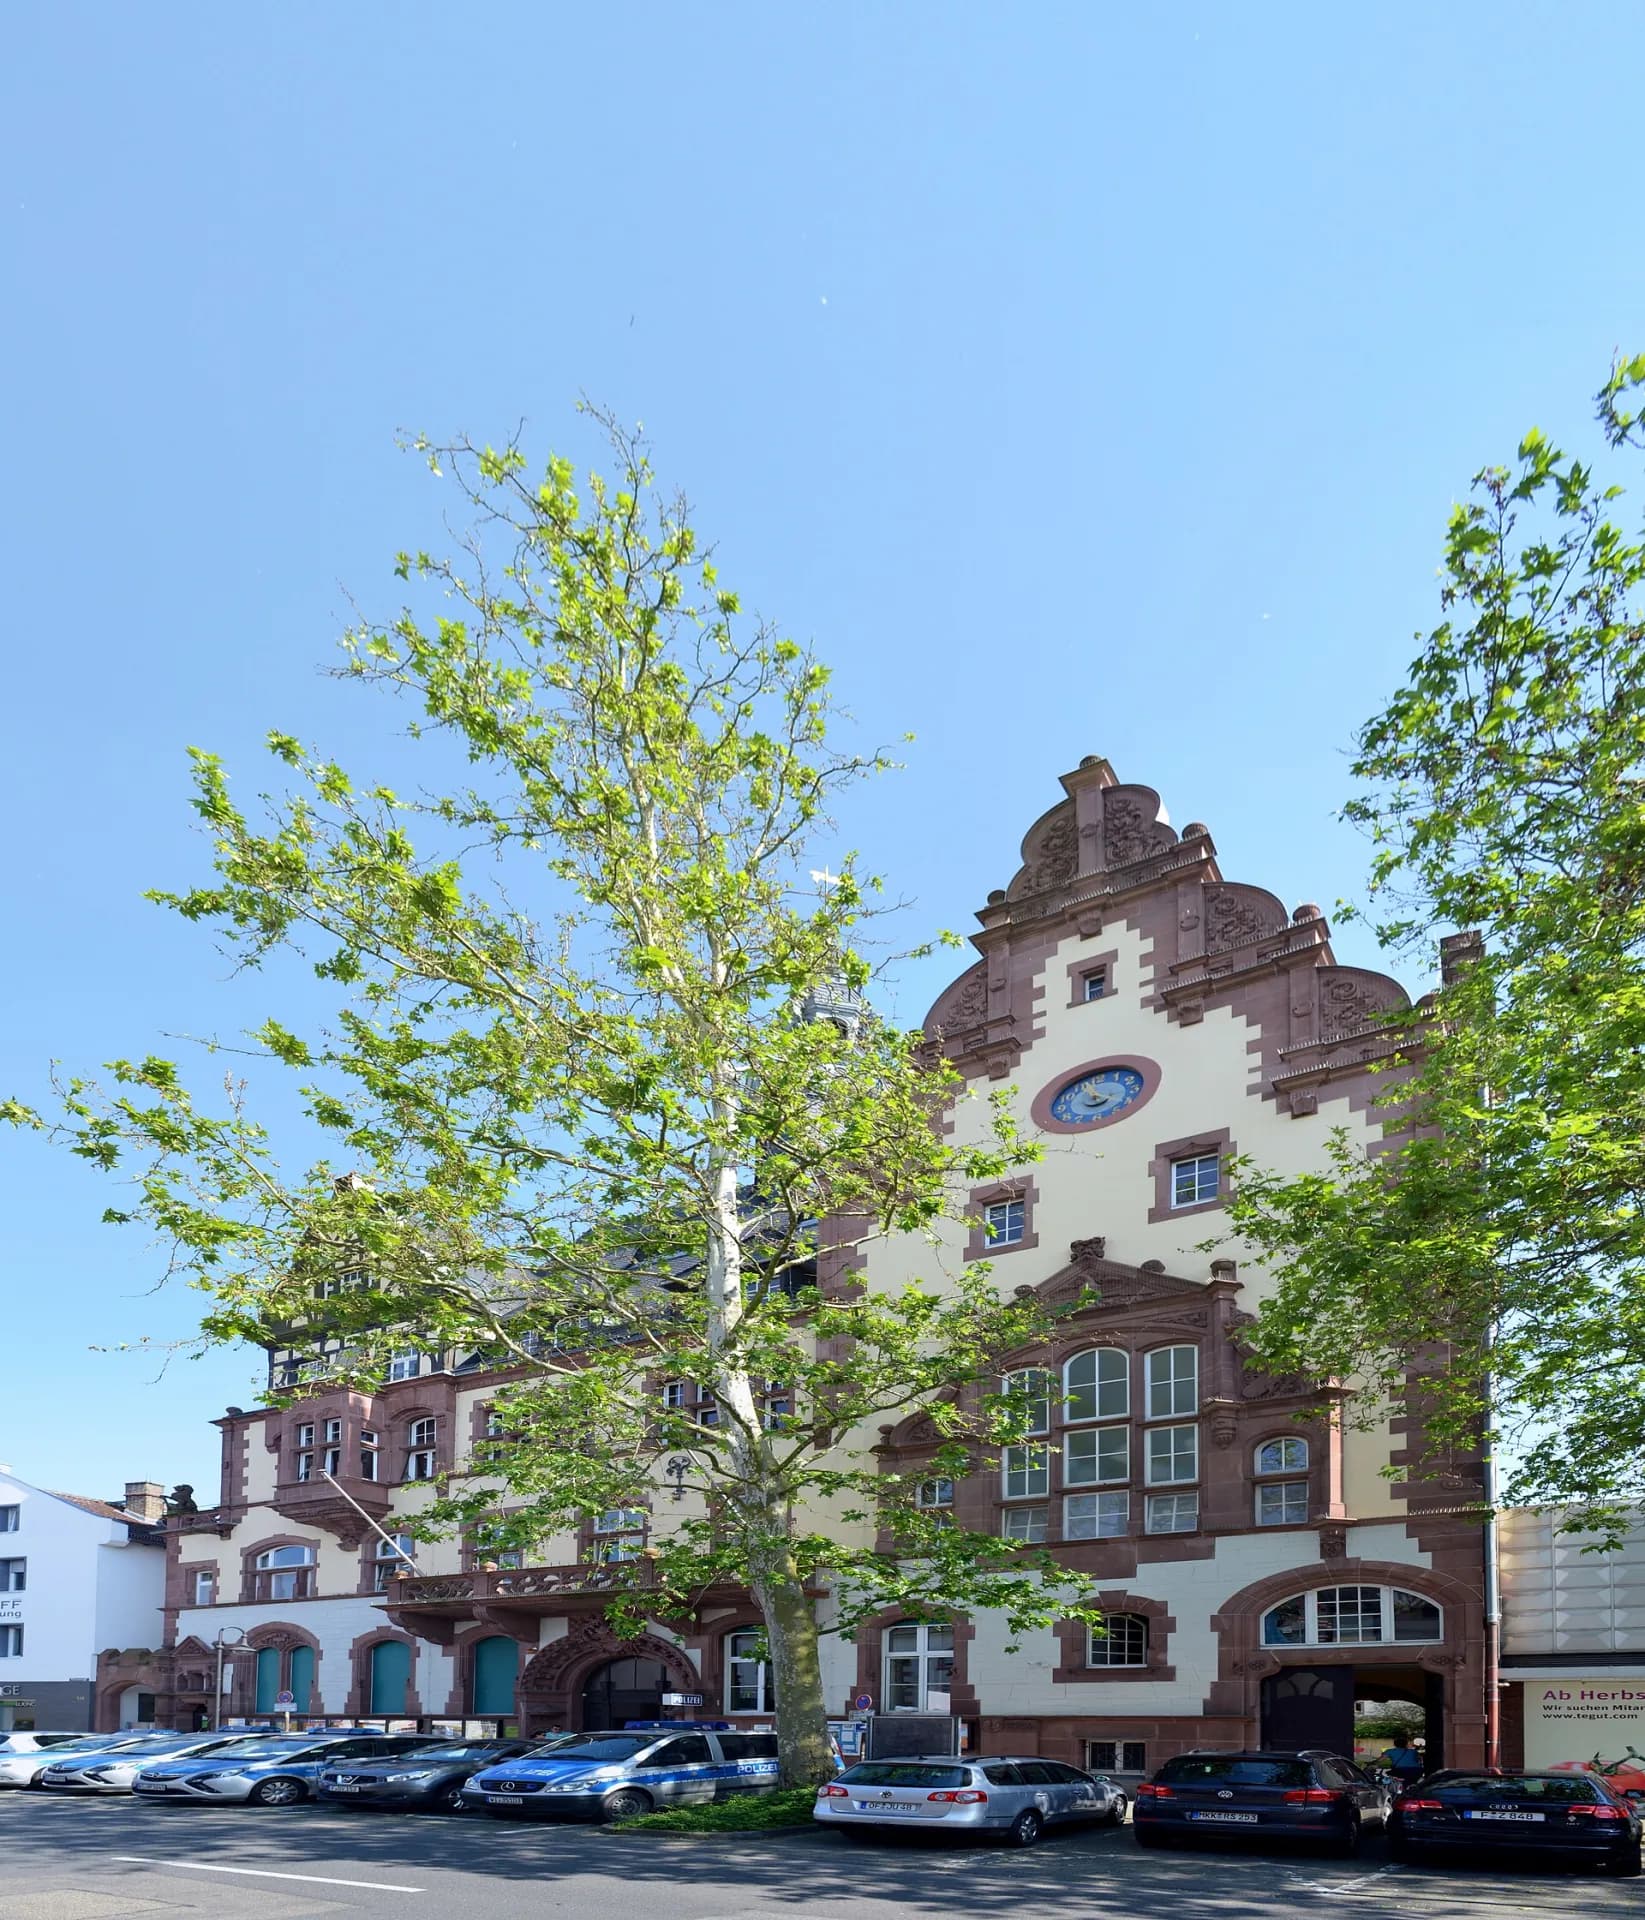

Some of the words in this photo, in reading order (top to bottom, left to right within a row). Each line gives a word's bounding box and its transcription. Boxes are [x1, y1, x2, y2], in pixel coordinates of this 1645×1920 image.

[0, 1600, 22, 1609] FF
[0, 1685, 20, 1696] GE
[1543, 1690, 1571, 1700] Ab
[1581, 1690, 1645, 1700] Herbs
[672, 1695, 701, 1705] POLIZEI
[737, 1763, 778, 1774] POLIZEI
